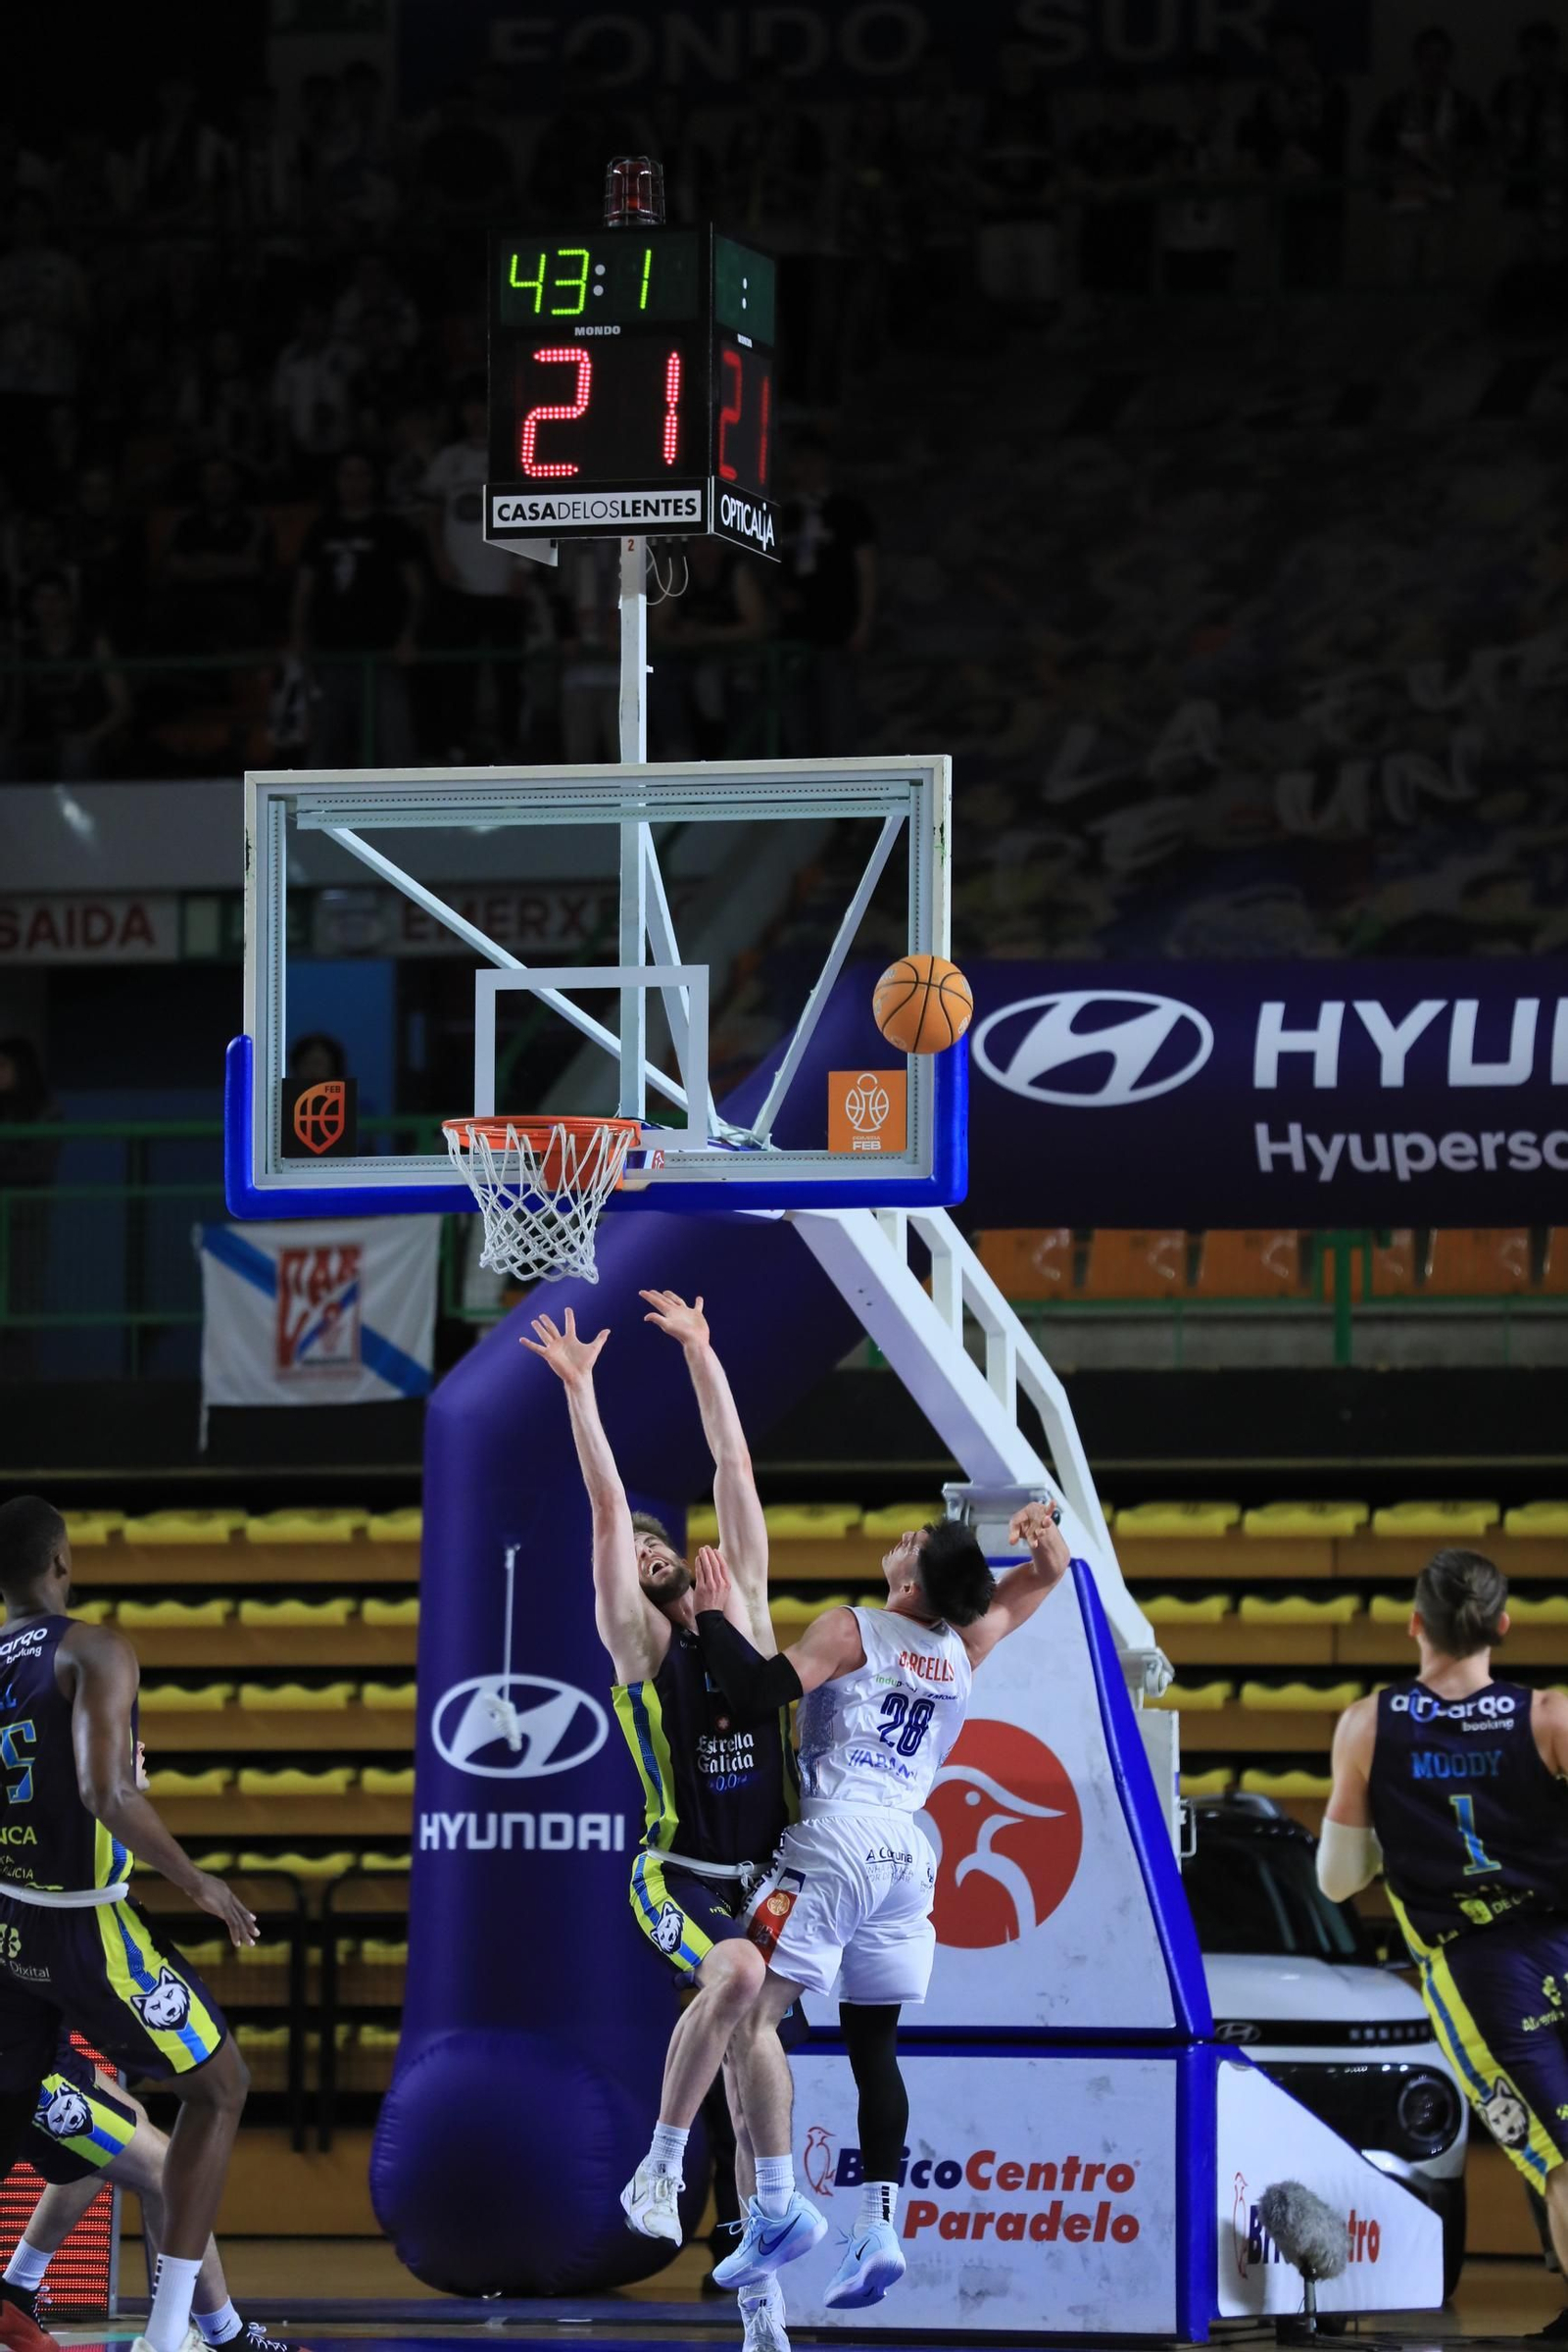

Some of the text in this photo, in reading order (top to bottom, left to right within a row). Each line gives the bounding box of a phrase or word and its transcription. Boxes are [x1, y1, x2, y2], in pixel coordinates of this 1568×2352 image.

[492, 2, 930, 88] FONDO
[574, 325, 621, 336] MONDO
[497, 497, 697, 522] CASADELOSLENTES
[627, 539, 635, 552] 2
[1253, 997, 1568, 1089] HYU
[324, 1085, 341, 1094] FEB
[853, 1141, 881, 1151] FEB
[877, 1692, 936, 1757] 28
[1461, 1718, 1515, 1733] booking
[695, 1732, 755, 1755] Estrella
[697, 1751, 755, 1774] Galicia
[1409, 1749, 1502, 1780] MOODY
[419, 1812, 626, 1851] HYUNDAI
[1448, 1794, 1502, 1877] 1
[9, 1960, 51, 1979] Dixital
[834, 2146, 1135, 2194] BicoCentro
[903, 2201, 1140, 2244] Paradelo
